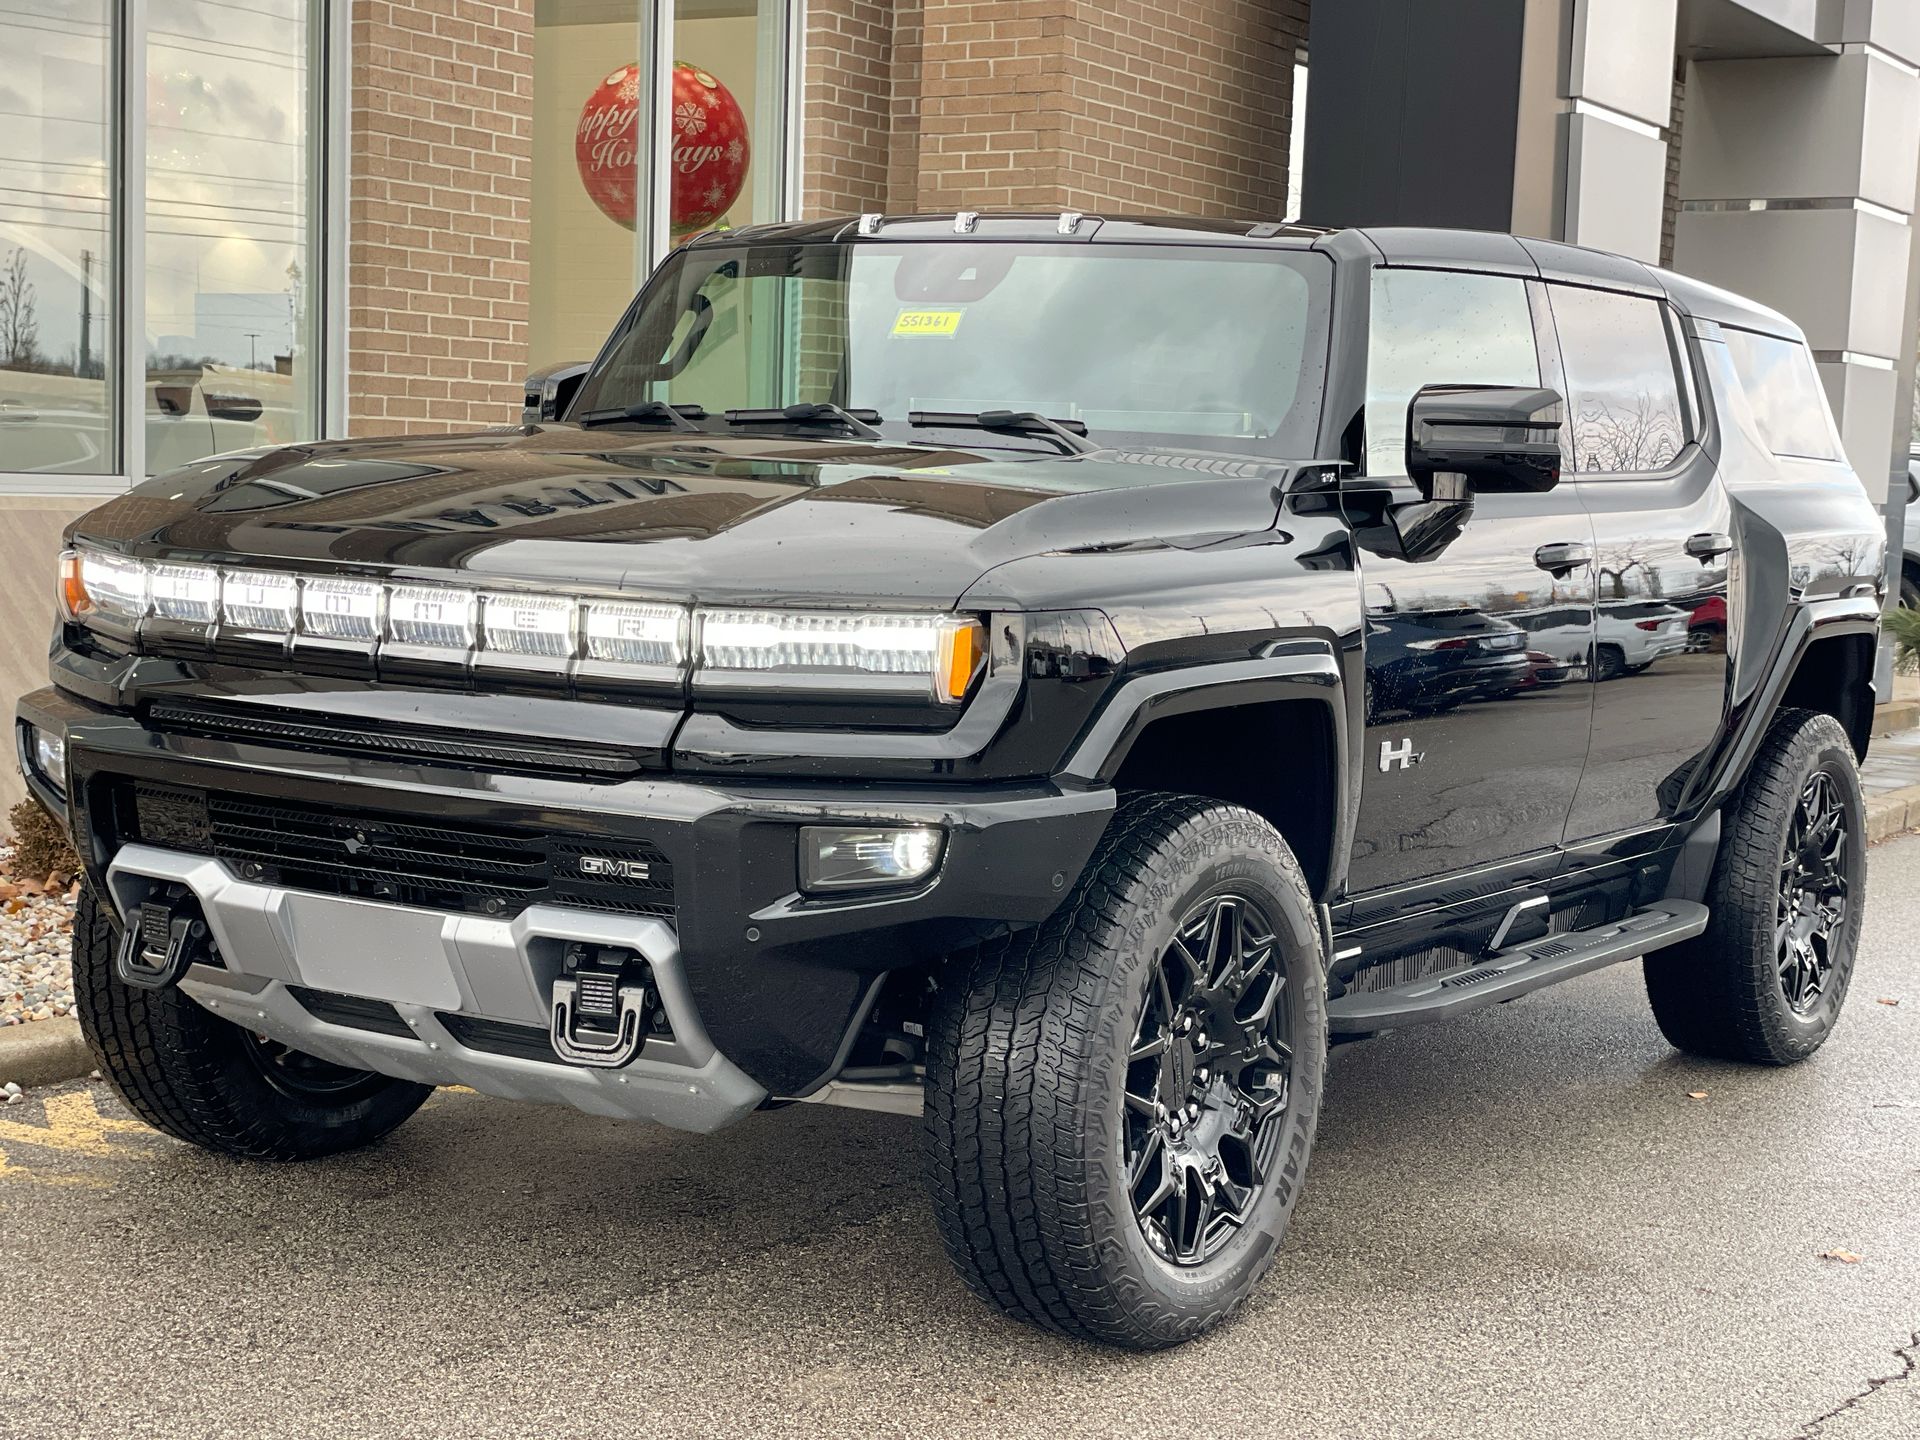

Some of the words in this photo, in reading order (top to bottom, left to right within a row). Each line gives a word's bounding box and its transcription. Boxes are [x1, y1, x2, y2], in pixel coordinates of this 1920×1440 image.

[900, 315, 949, 327] 551361
[173, 580, 645, 638] HUMMER
[579, 857, 650, 880] GMC
